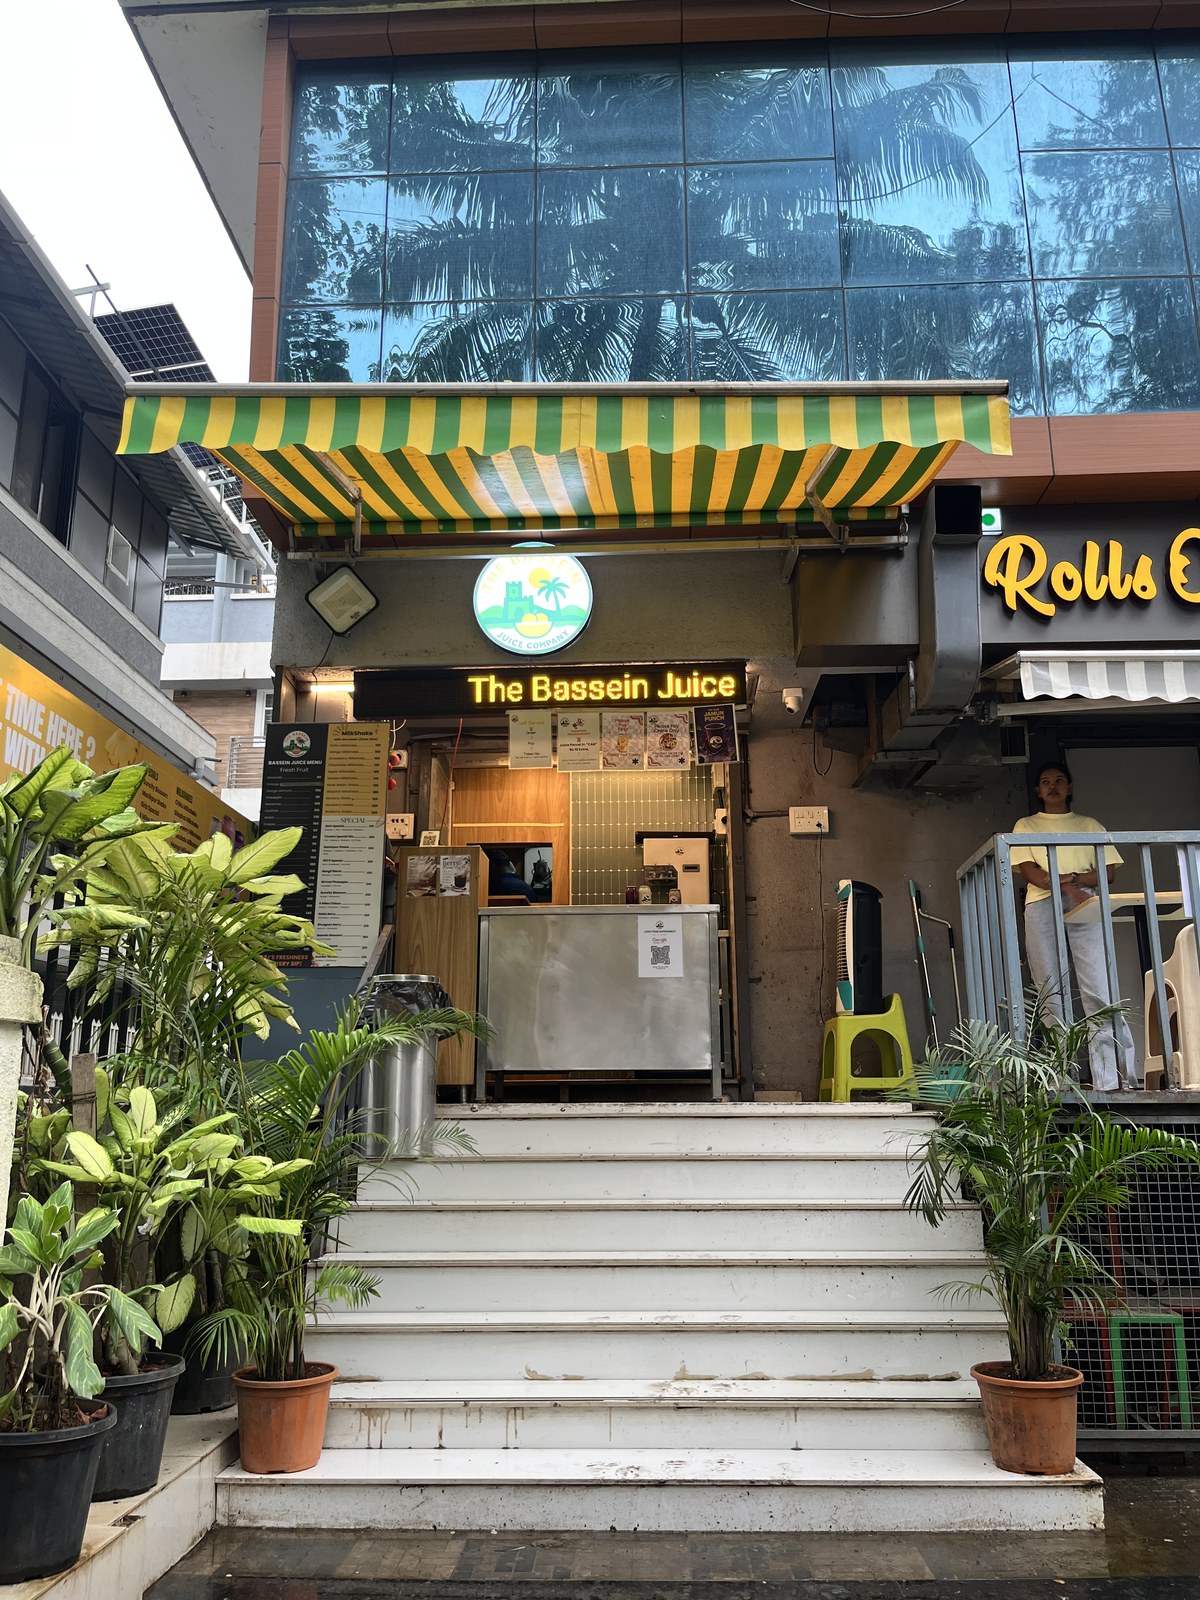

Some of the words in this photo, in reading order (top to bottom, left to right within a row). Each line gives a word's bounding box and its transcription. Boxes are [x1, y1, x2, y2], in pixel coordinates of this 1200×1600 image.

[984, 534, 1157, 617] Rolls
[497, 632, 523, 648] JUICE
[526, 629, 569, 649] COMPANY
[467, 674, 523, 704] The
[532, 673, 649, 702] Bassein
[657, 671, 737, 699] Juice
[4, 683, 46, 740] TIME
[45, 710, 84, 762] HERE
[4, 726, 46, 774] WITH
